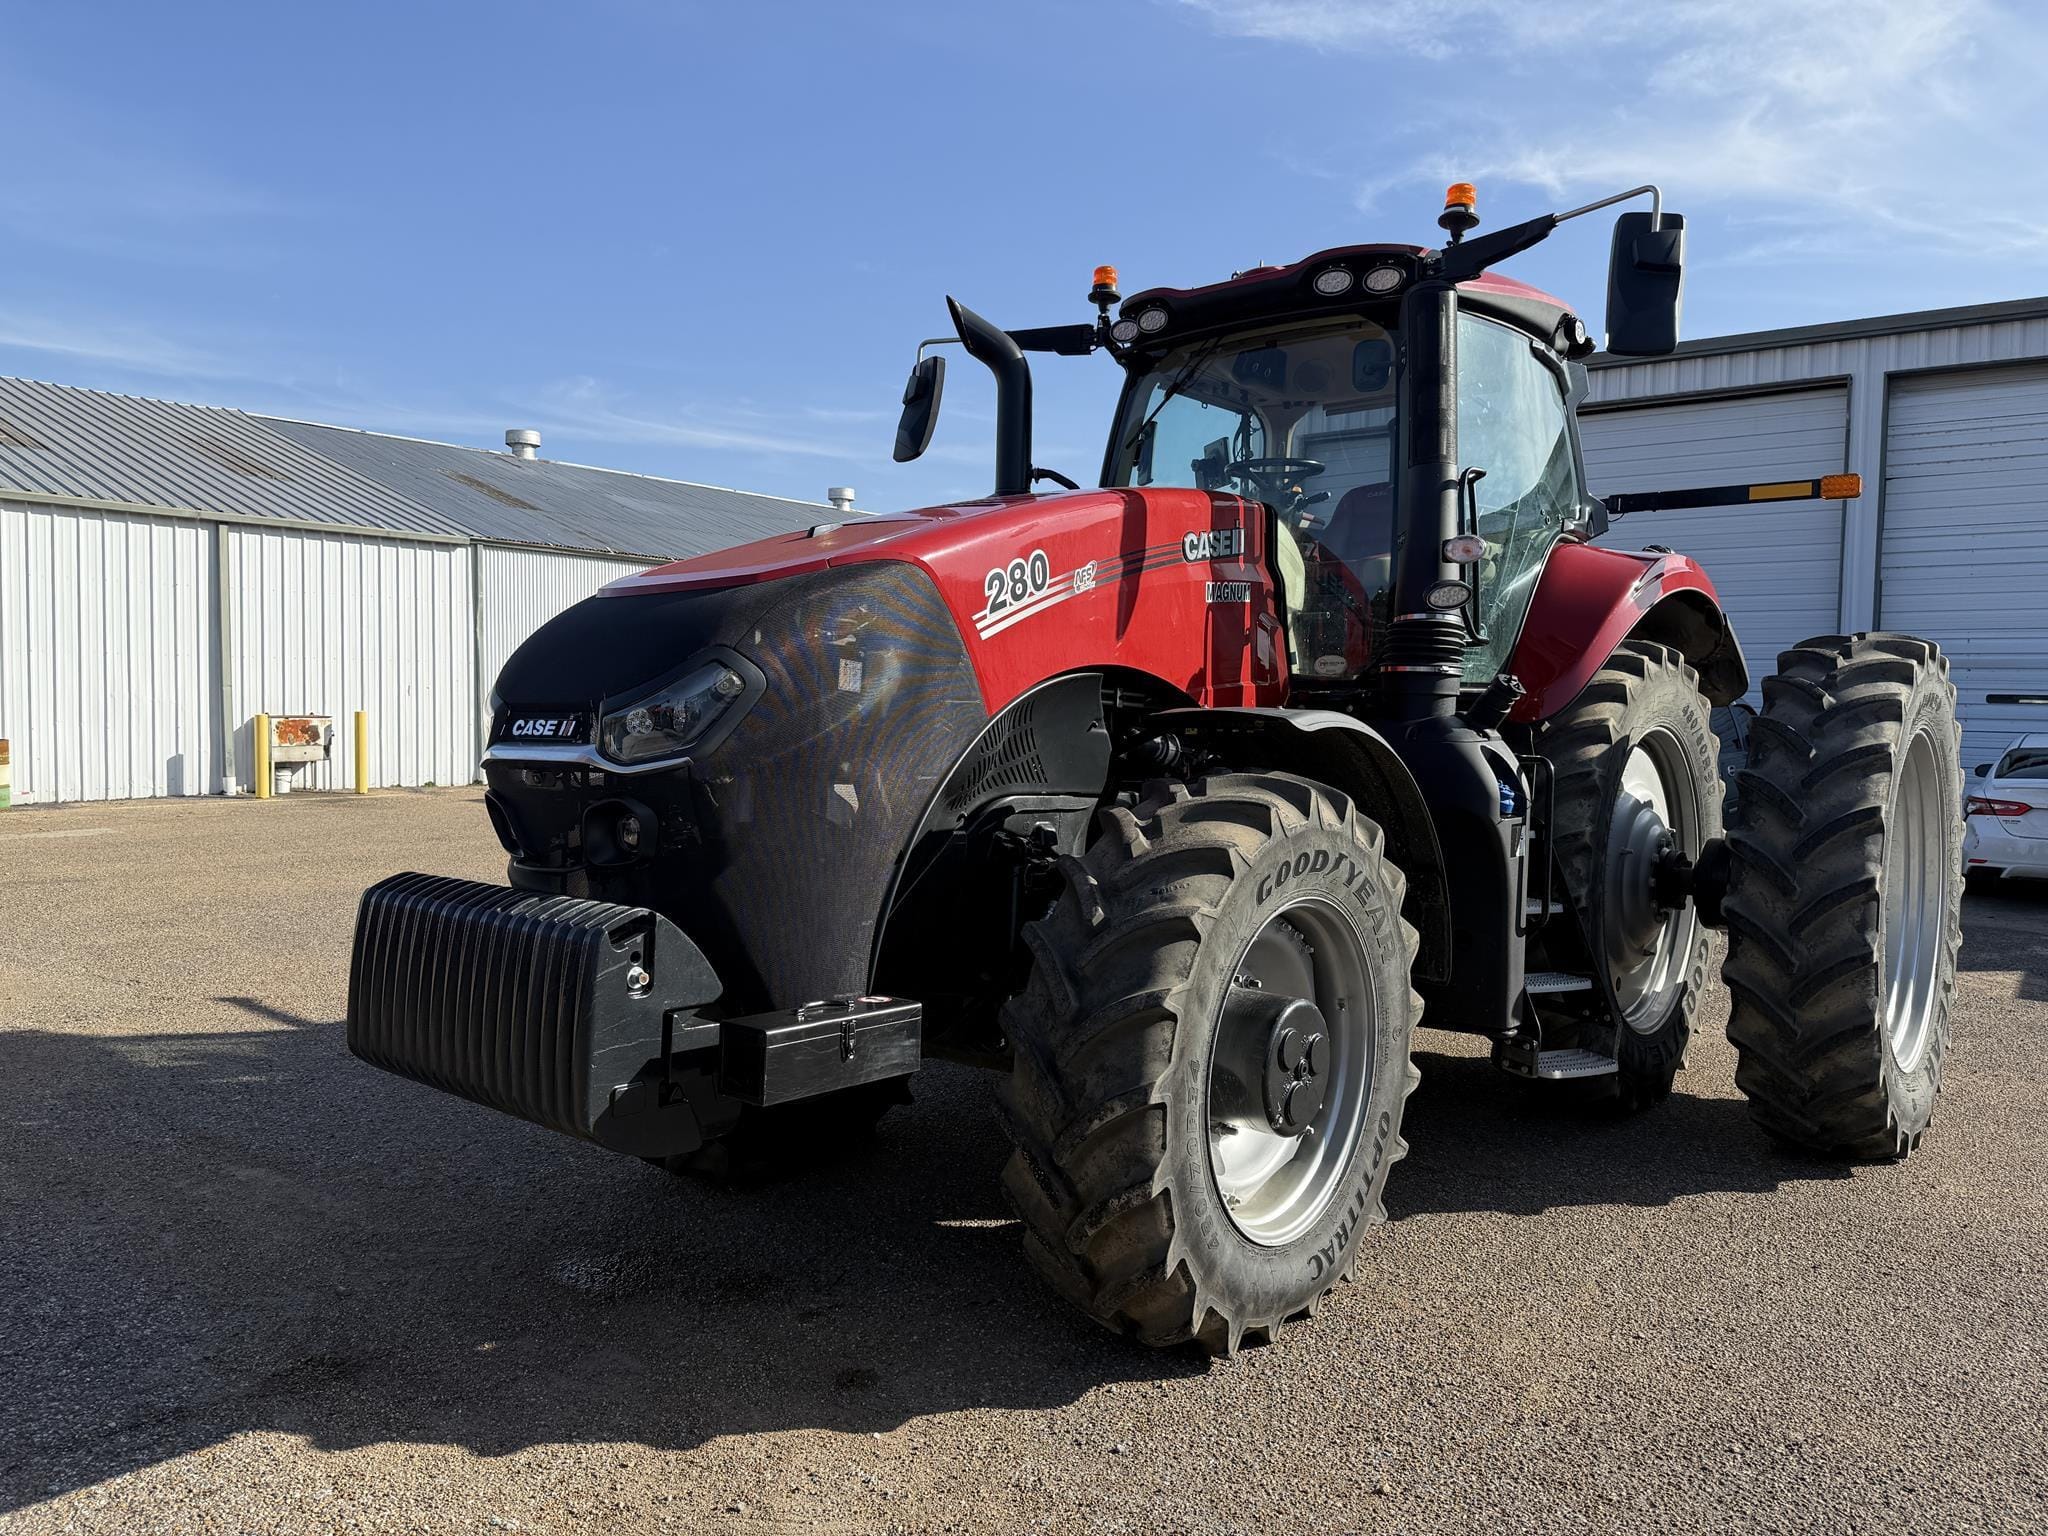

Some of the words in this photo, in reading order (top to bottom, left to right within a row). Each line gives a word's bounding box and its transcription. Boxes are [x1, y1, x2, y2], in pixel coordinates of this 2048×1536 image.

[1184, 530, 1230, 561] CASE
[985, 549, 1050, 616] 280
[1075, 566, 1092, 586] AFS
[1205, 581, 1251, 603] MAGNUM
[512, 719, 557, 736] CASE
[1256, 849, 1397, 964] GOODYEAR
[1307, 1111, 1391, 1281] OPTITRAC
